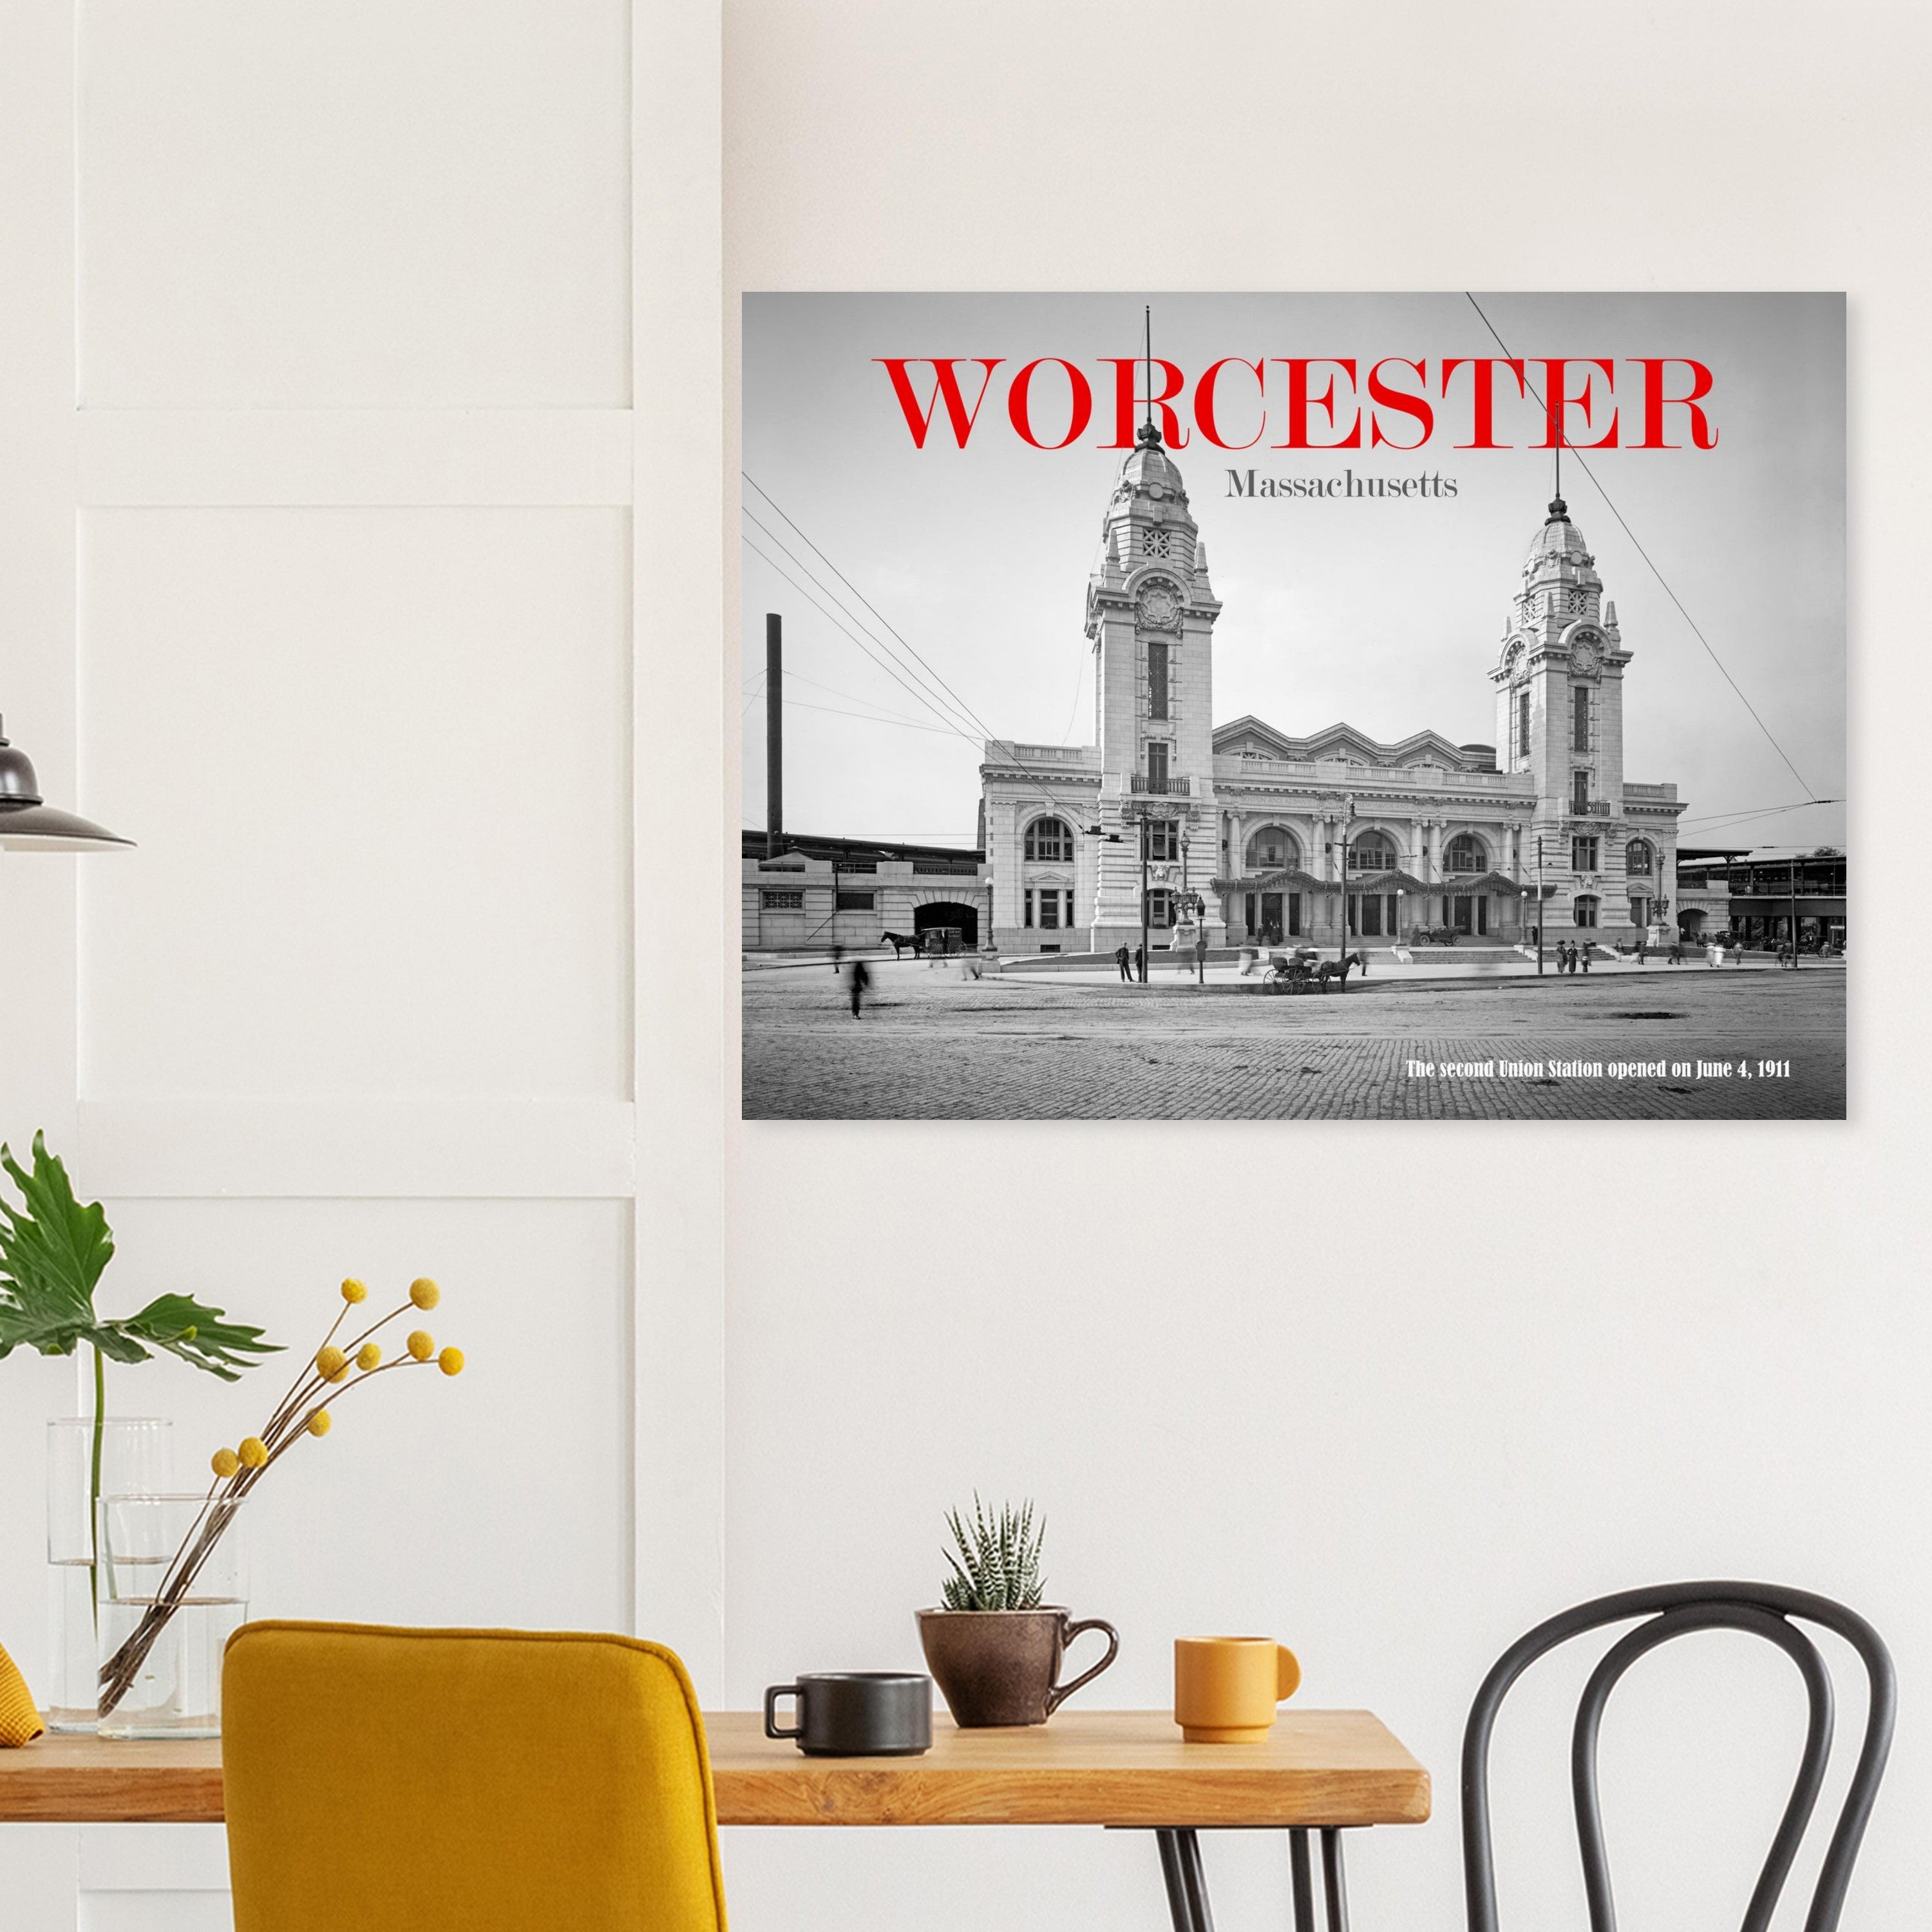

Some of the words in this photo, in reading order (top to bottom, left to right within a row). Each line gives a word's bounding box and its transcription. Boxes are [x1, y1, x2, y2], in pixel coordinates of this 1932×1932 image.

[871, 357, 1719, 450] WORCESTER
[1225, 469, 1458, 497] Massachusetts
[1405, 1059, 1435, 1077] The
[1439, 1059, 1494, 1077] second
[1499, 1059, 1544, 1077] Union
[1548, 1059, 1603, 1077] Station
[1608, 1059, 1666, 1080] opened
[1672, 1062, 1691, 1077] on
[1696, 1059, 1732, 1080] June
[1737, 1059, 1752, 1080] 4,
[1757, 1059, 1790, 1077] 1911
